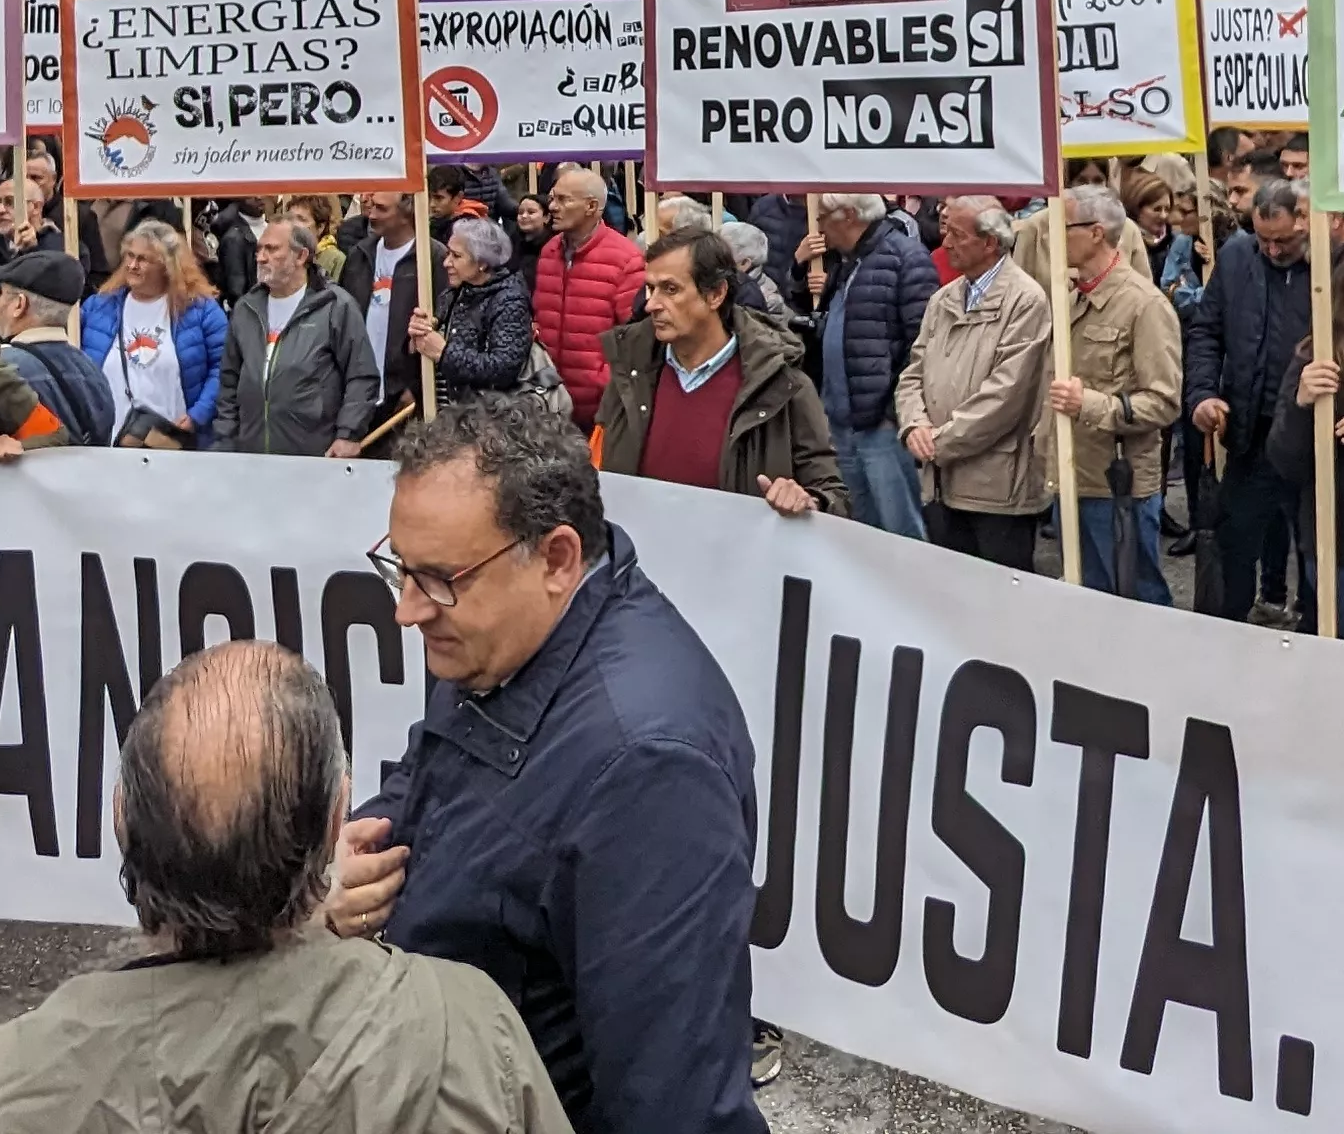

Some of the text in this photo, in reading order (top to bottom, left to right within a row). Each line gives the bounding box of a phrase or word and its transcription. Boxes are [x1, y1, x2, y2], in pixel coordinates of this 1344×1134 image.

[419, 2, 613, 54] EXPROPIACIÓN
[672, 13, 957, 71] RENOVABLES
[1210, 7, 1274, 43] JUSTA?
[105, 37, 359, 80] LIMPIAS?
[701, 78, 987, 145] PERO NO ASÍ
[173, 139, 395, 176] sin joder nuestro Bierzo
[748, 574, 1316, 1116] JUSTA.
